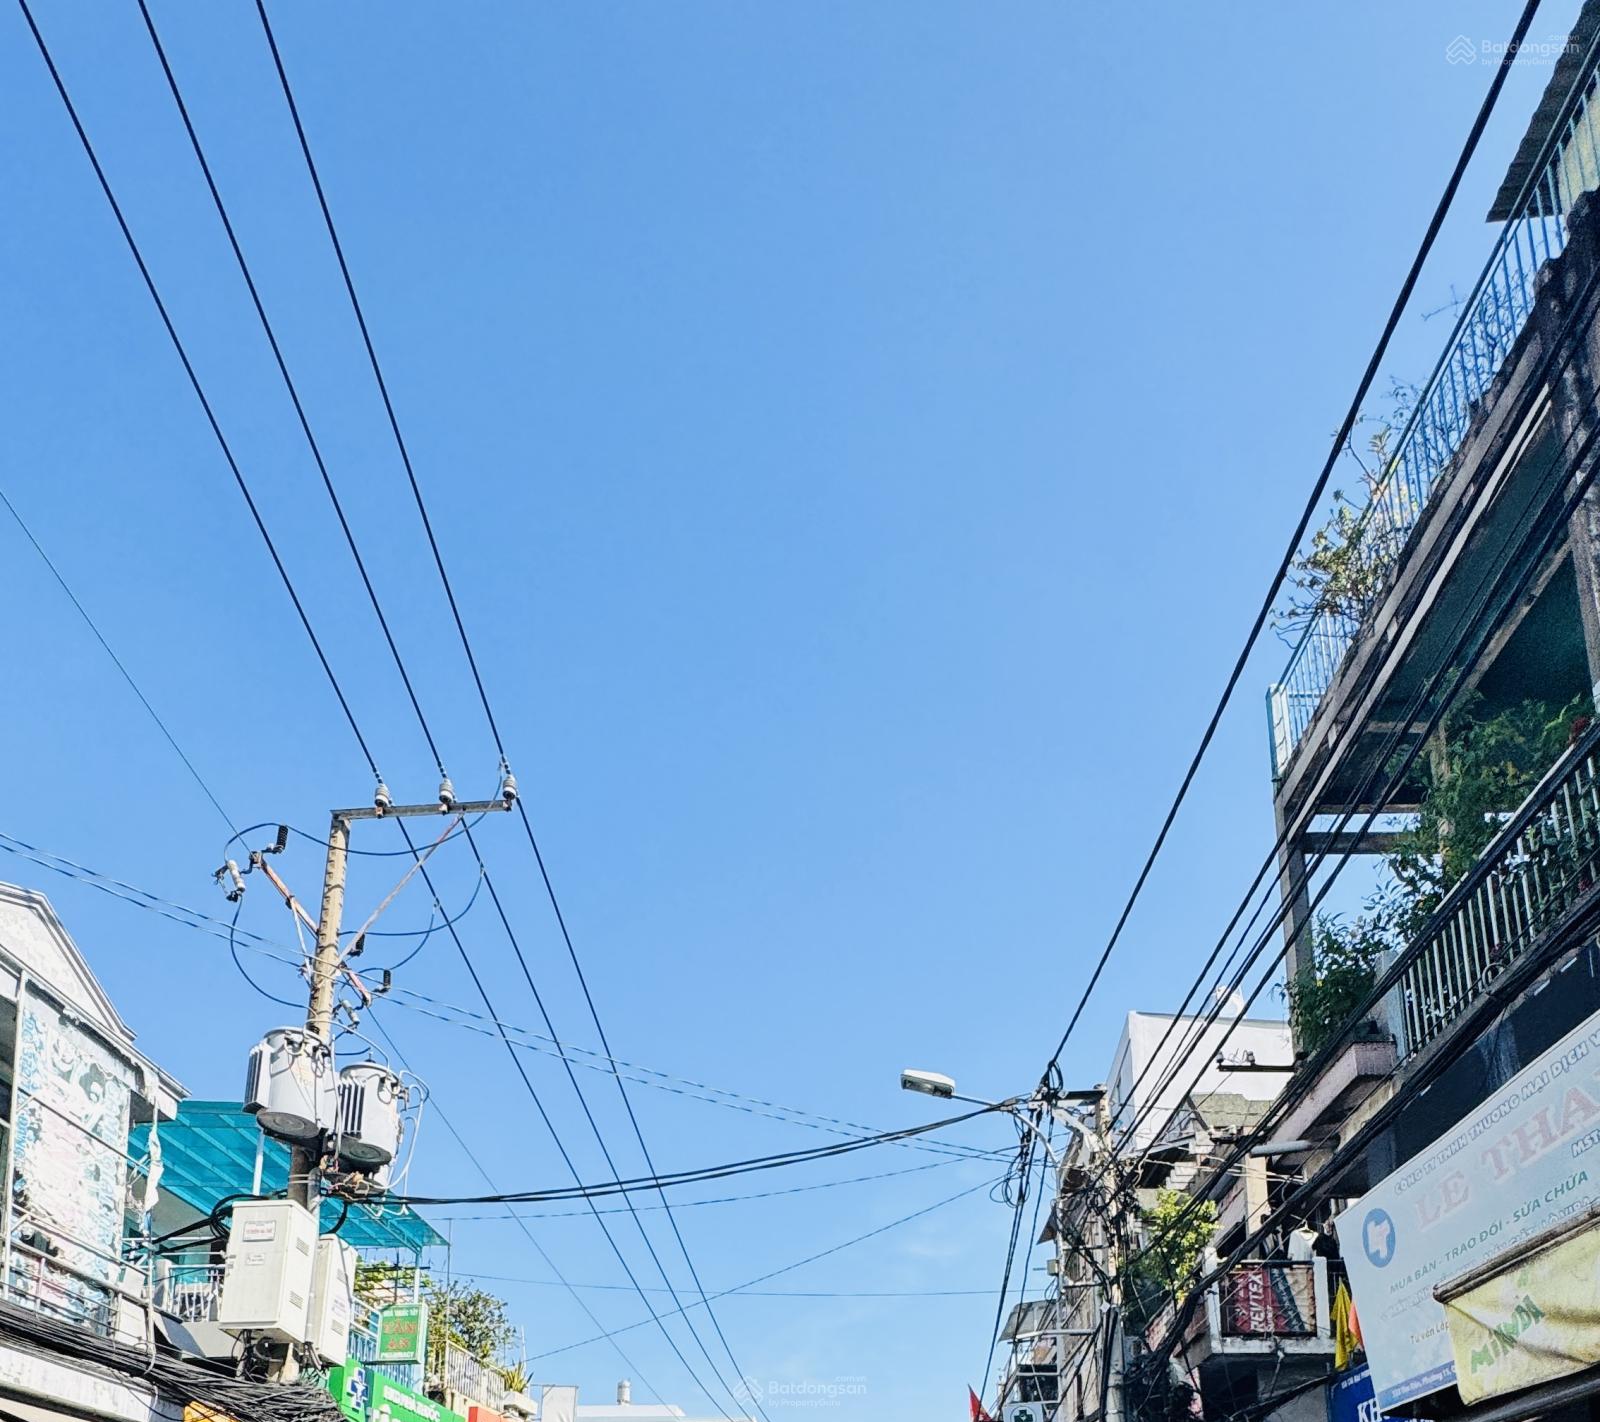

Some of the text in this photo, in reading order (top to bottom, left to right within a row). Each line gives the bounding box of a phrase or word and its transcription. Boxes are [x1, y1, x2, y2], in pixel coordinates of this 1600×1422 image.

[1521, 1071, 1548, 1101] MẠI
[1549, 1040, 1590, 1078] DỊCH
[1481, 1069, 1600, 1182] THA
[1390, 1275, 1413, 1295] MUA
[1444, 1239, 1477, 1263] TRAO
